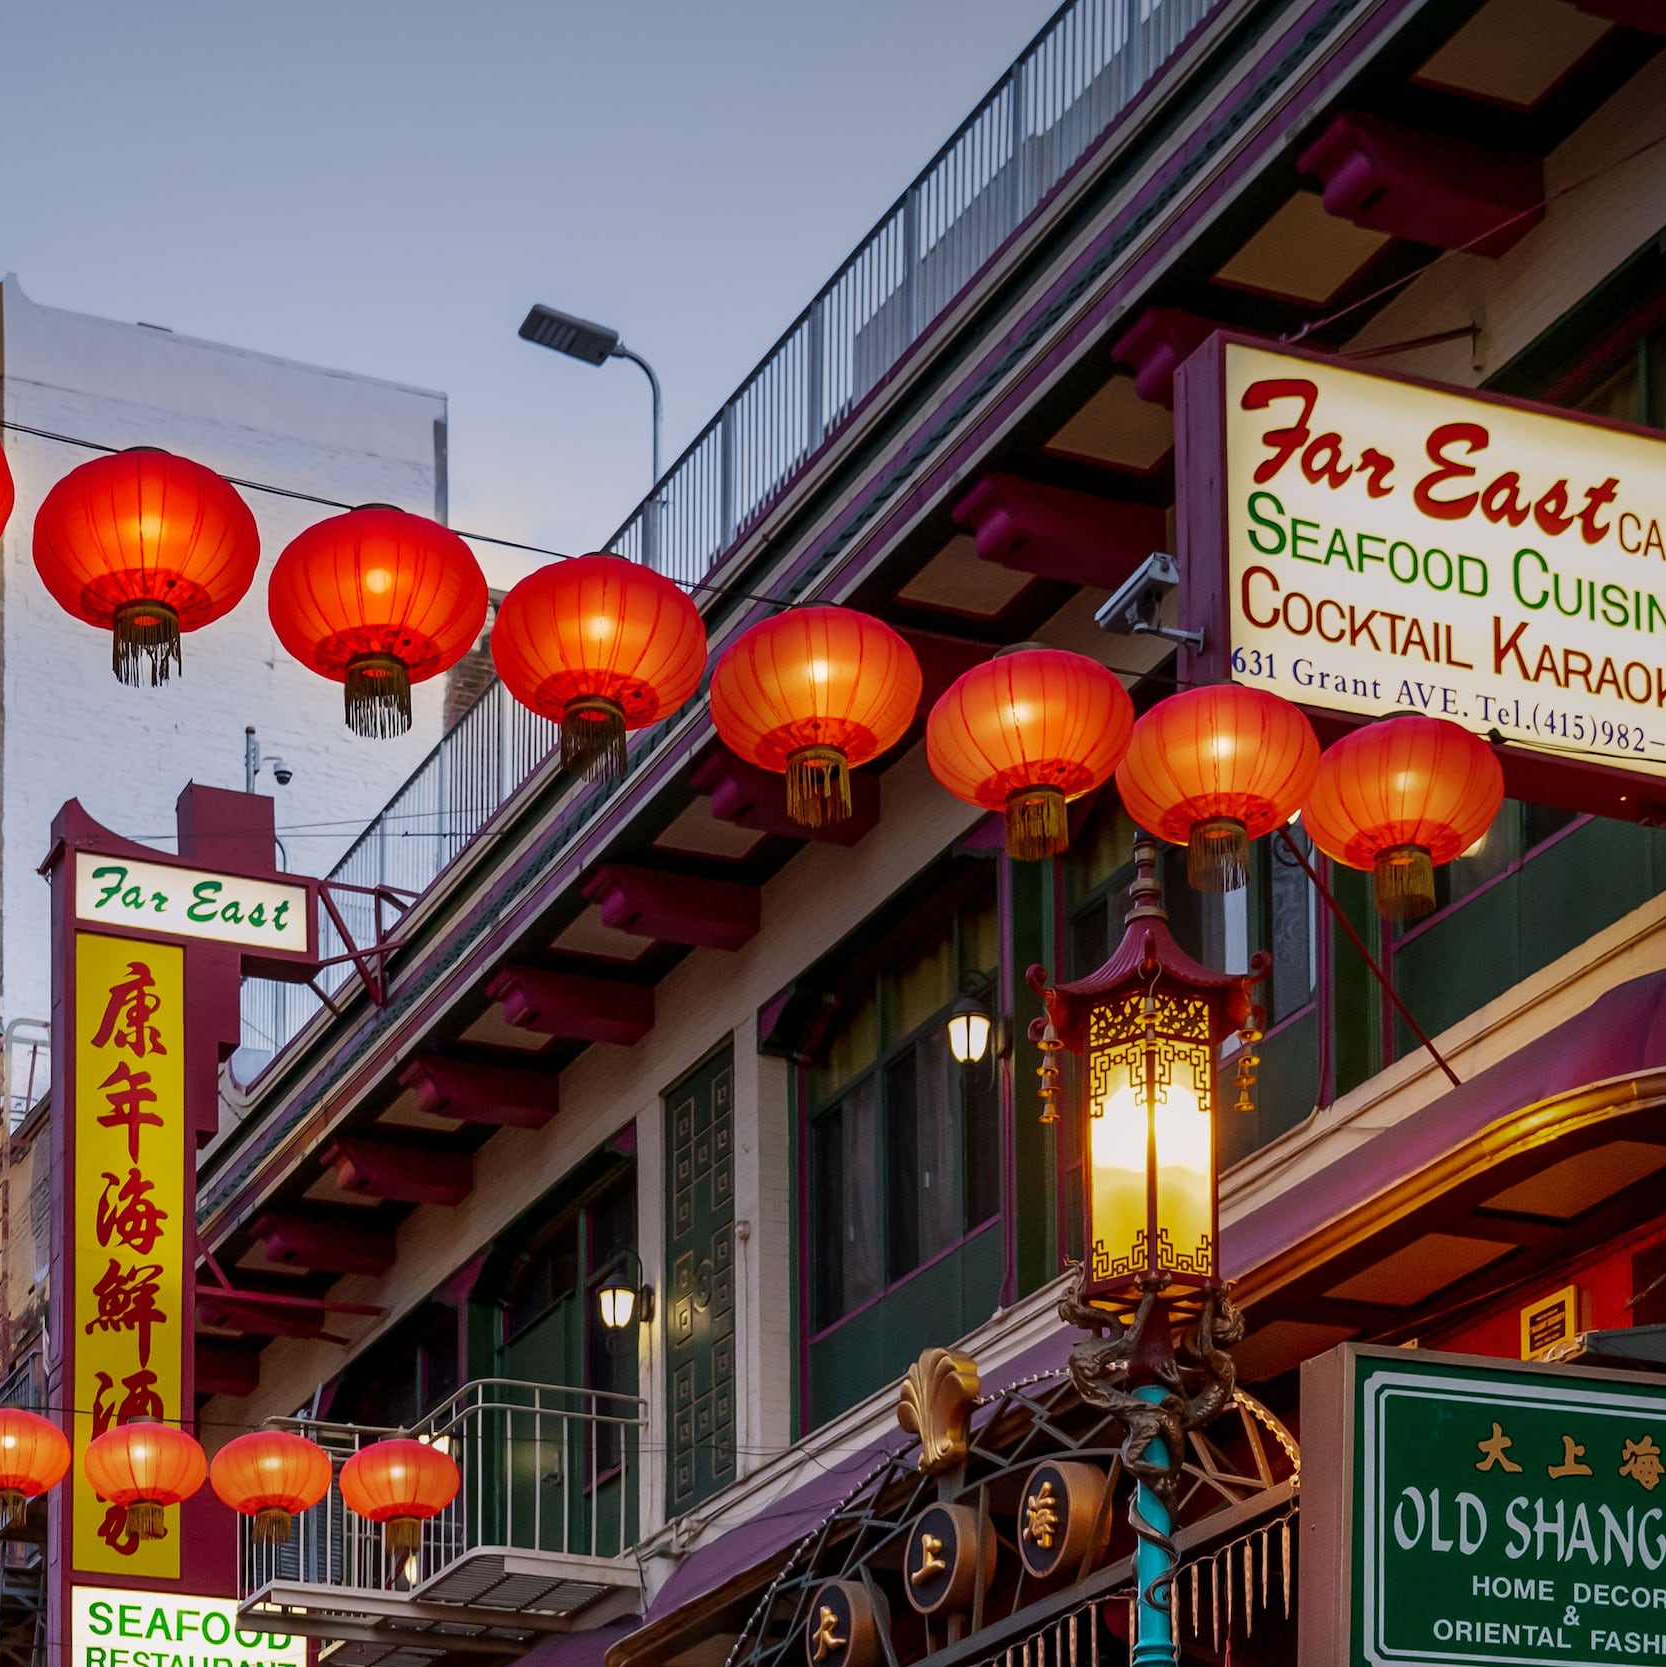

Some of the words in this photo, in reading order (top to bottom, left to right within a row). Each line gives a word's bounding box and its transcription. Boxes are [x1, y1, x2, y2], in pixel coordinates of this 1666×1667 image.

[1241, 378, 1396, 498] Far
[1413, 422, 1620, 544] East
[1247, 491, 1489, 598] SEAFOOD
[1241, 566, 1473, 669] COCKTAIL
[1232, 647, 1277, 680] 631
[1292, 658, 1382, 700] Grant
[1395, 681, 1469, 718] AVE.
[91, 866, 169, 912] Far
[186, 880, 289, 931] East
[1475, 1421, 1666, 1492] 大上海
[1393, 1486, 1488, 1554] OLD
[1472, 1575, 1555, 1601] HOME
[1562, 1605, 1581, 1627] &
[1433, 1619, 1571, 1649] ORIENTAL
